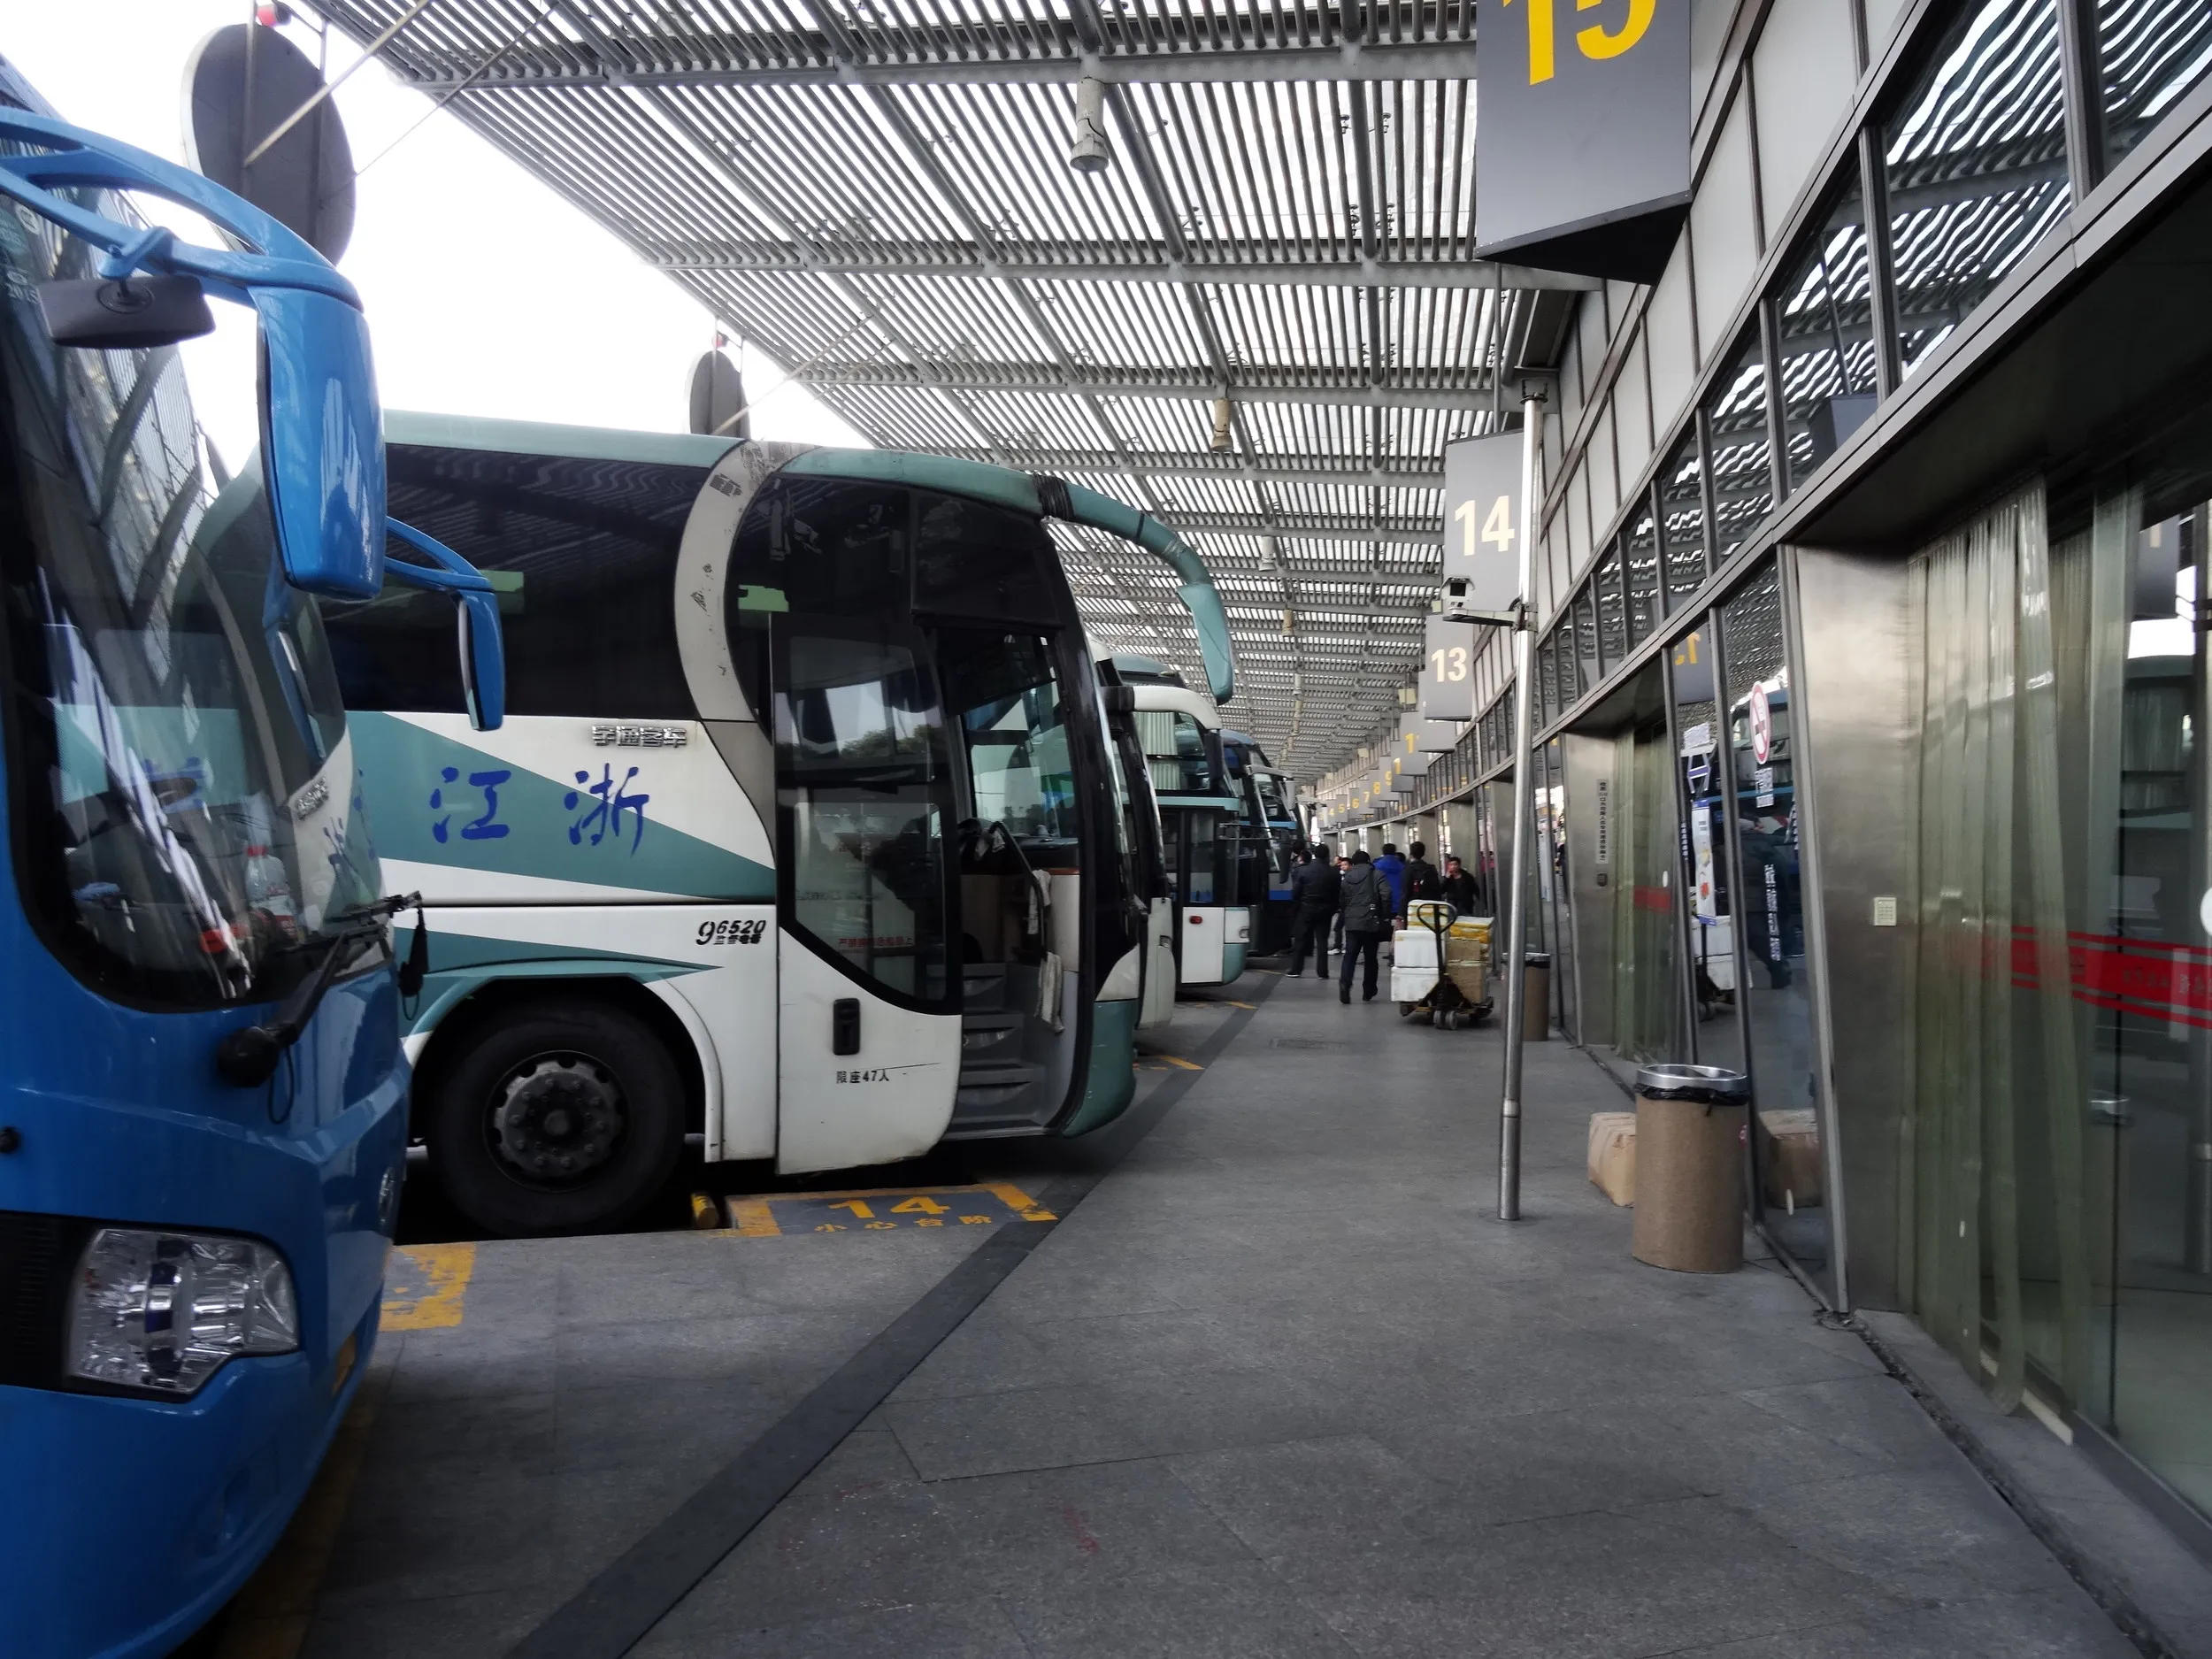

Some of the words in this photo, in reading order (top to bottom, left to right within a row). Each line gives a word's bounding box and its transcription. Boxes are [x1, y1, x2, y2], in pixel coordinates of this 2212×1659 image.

[1503, 0, 1656, 86] 15
[1454, 495, 1516, 557] 14
[1431, 647, 1468, 683] 13
[591, 725, 687, 748] 宇通客车
[1385, 771, 1392, 787] 9
[1373, 781, 1381, 795] 8
[1352, 798, 1360, 809] 6
[1363, 791, 1370, 803] 7
[1329, 808, 1335, 817] 4
[1338, 803, 1345, 814] 5
[695, 919, 767, 946] 96520
[836, 1068, 890, 1084] 限座47人
[827, 1195, 951, 1219] 14
[814, 1214, 993, 1233] 小心台阶
